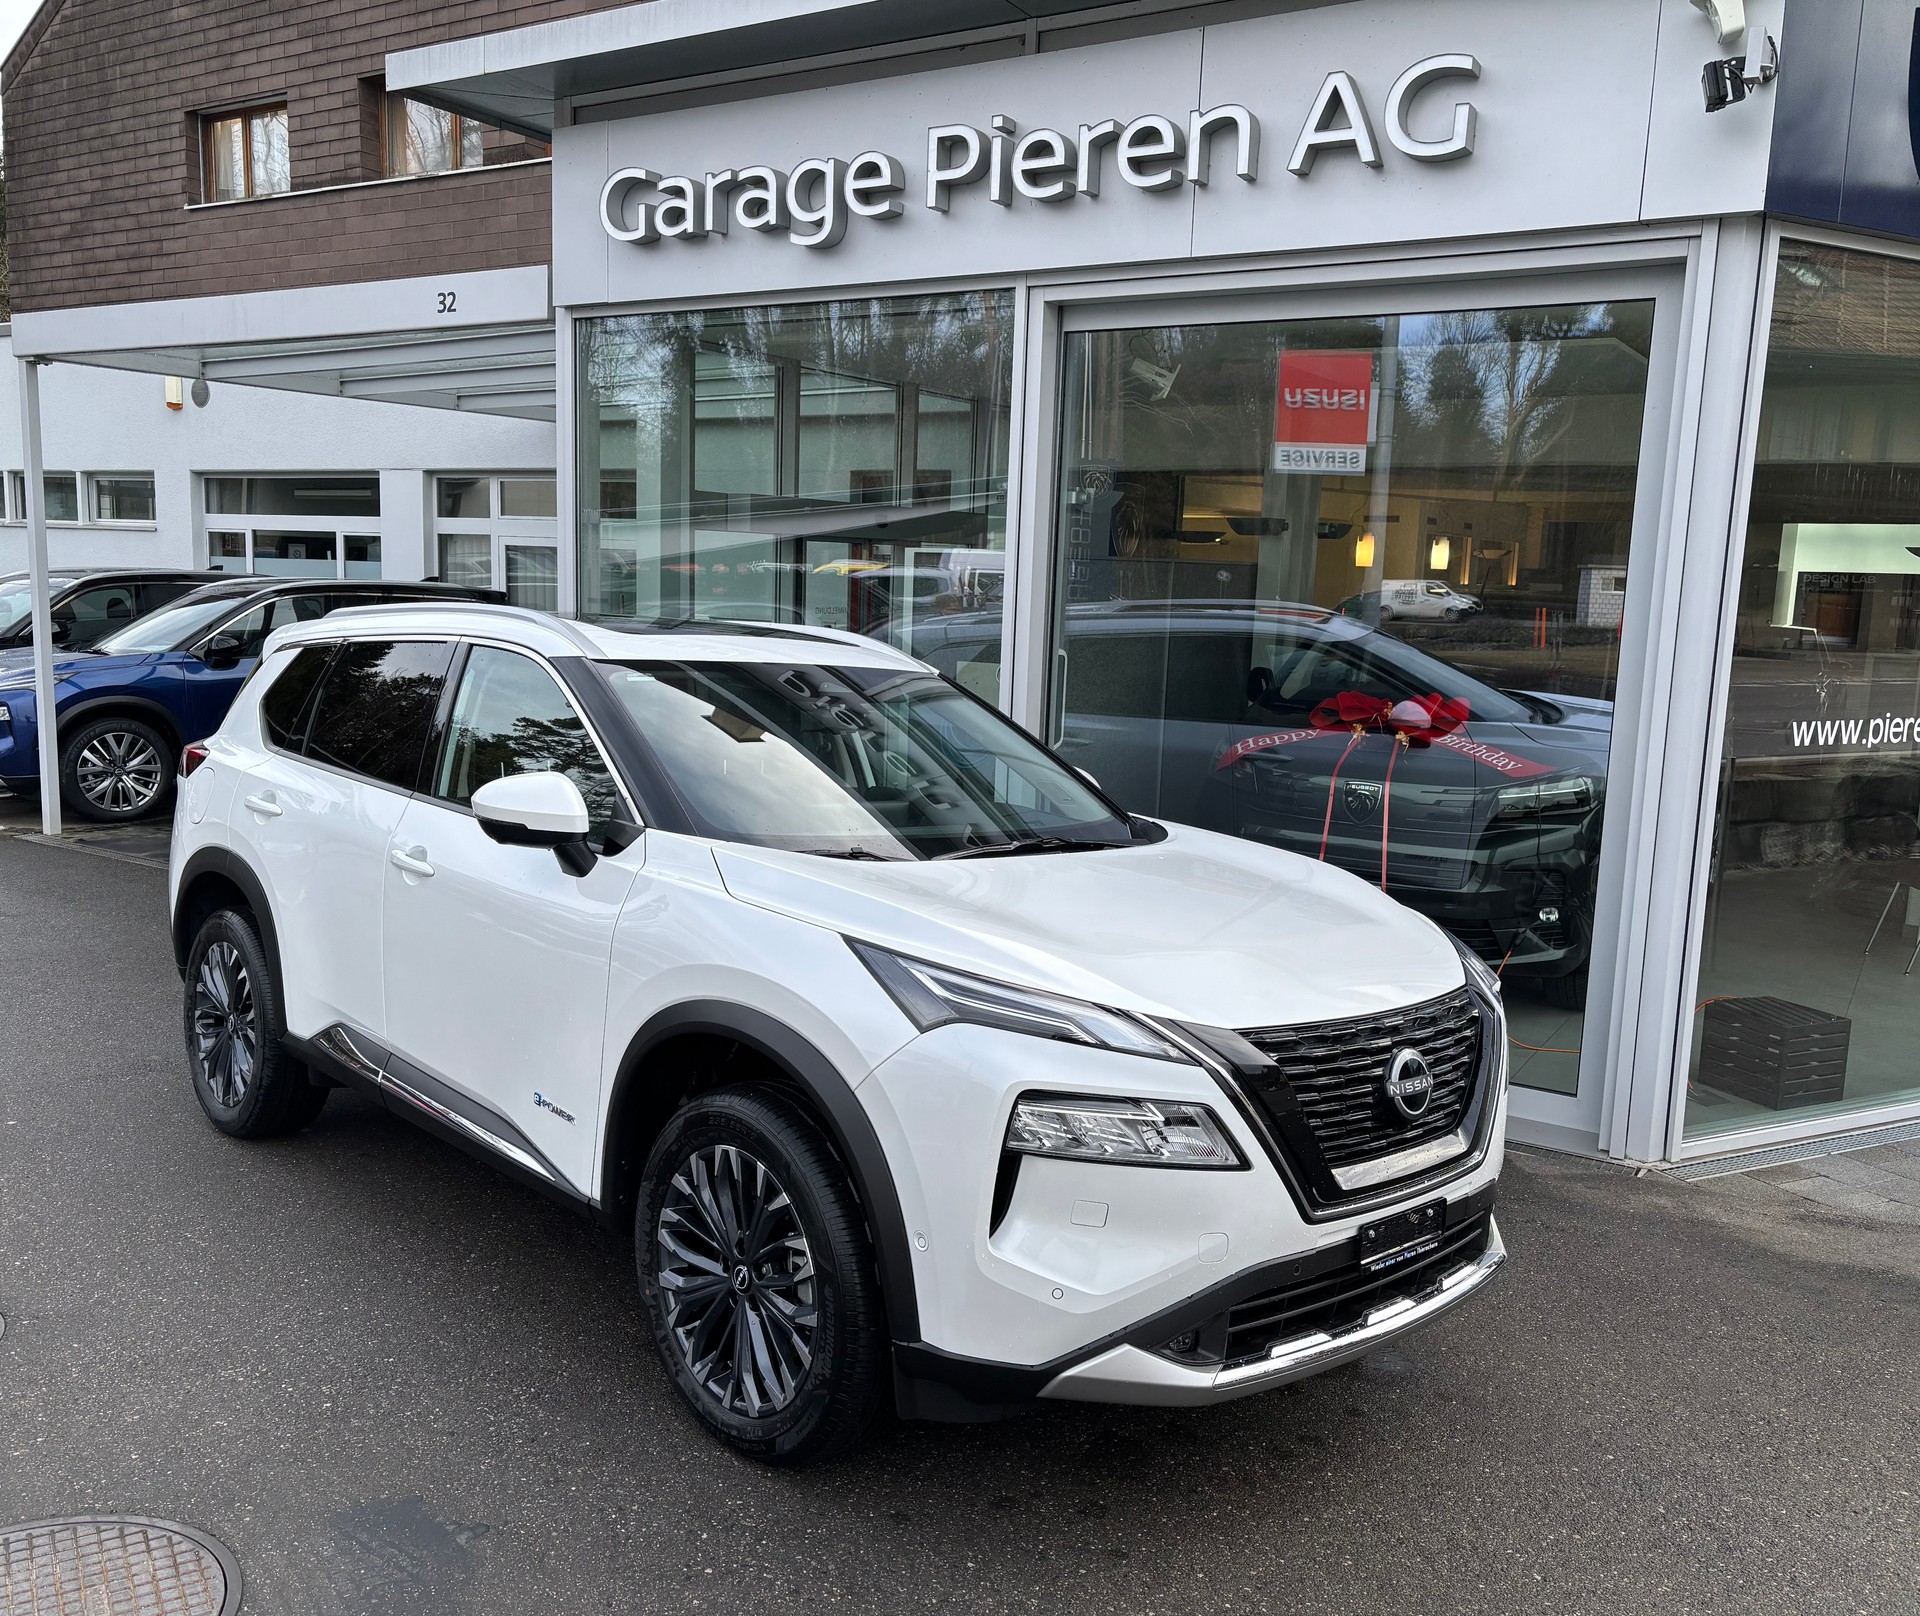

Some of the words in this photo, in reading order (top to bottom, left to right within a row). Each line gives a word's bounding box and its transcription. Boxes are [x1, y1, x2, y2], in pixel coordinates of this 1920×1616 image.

[599, 150, 905, 249] Garage
[926, 103, 1261, 213] Pieren
[1286, 53, 1482, 176] AG
[437, 291, 457, 314] 32
[1852, 575, 1876, 584] LAB
[1234, 728, 1321, 755] Happy
[1432, 734, 1523, 771] Birthday
[1390, 1076, 1433, 1096] NISSAN
